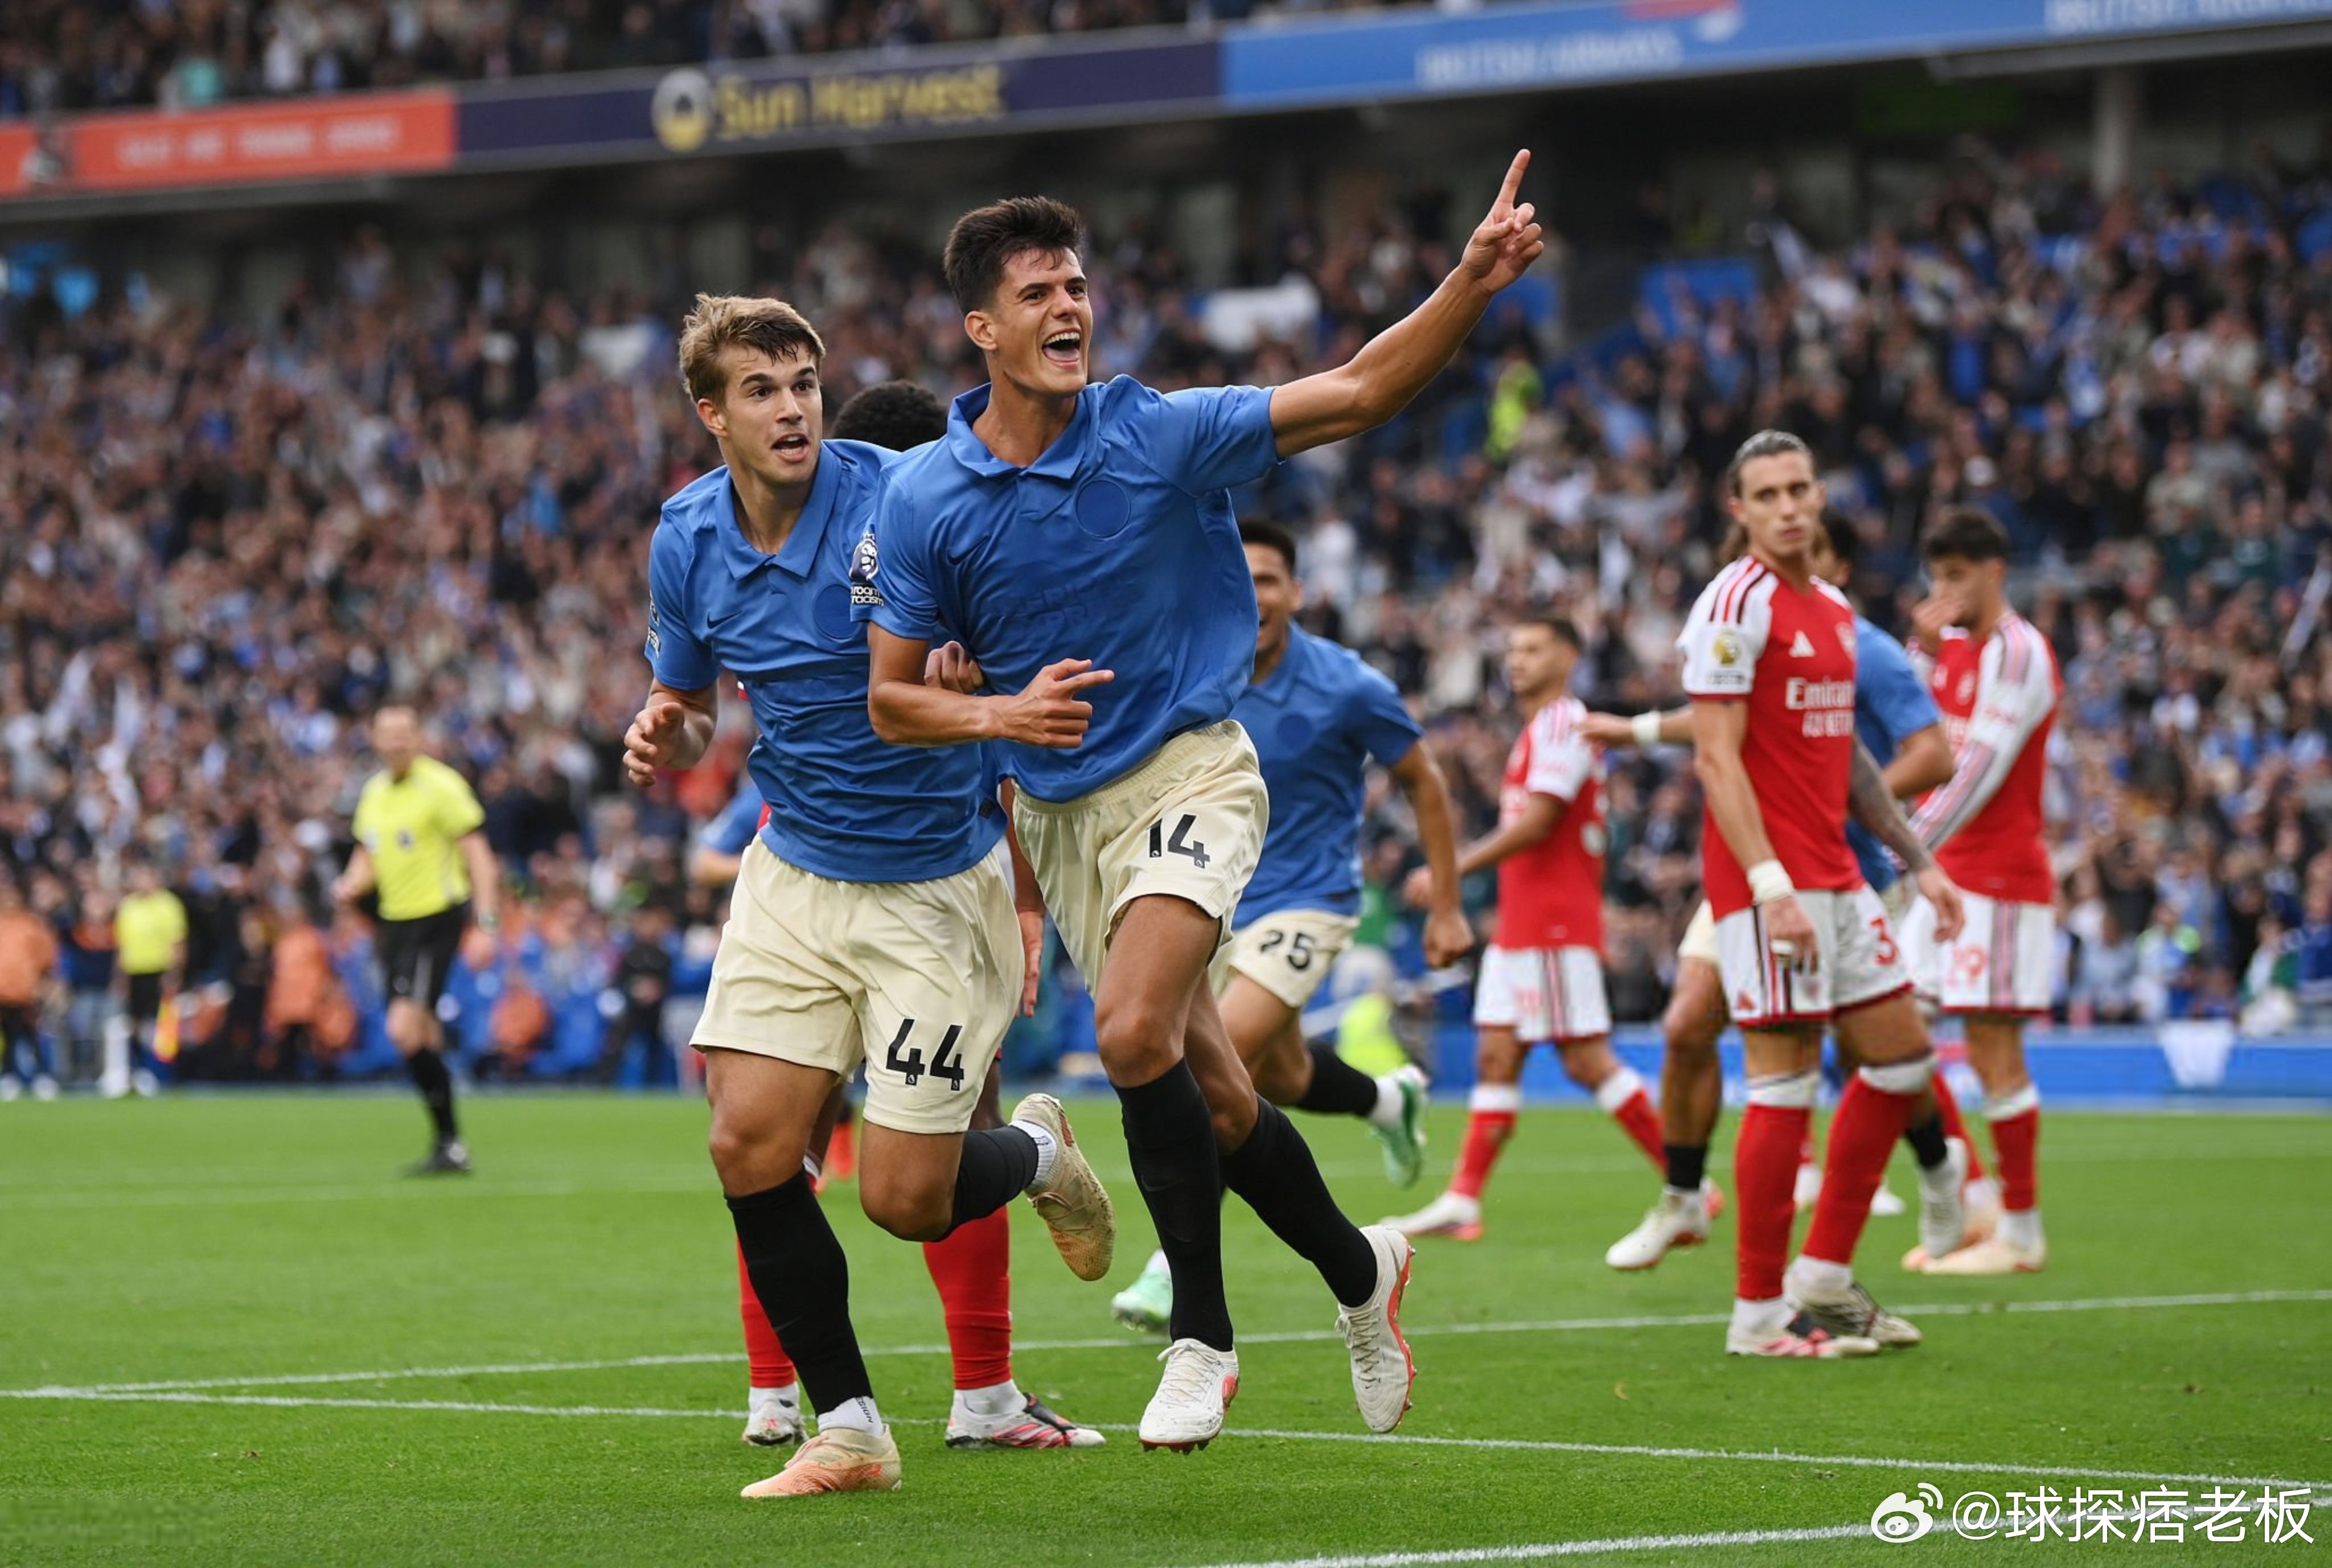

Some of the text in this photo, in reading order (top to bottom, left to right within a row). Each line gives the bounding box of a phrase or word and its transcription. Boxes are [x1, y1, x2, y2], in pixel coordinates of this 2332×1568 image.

[715, 63, 1003, 139] Sun Harvest
[1147, 814, 1210, 869] 14
[1259, 929, 1316, 972] 25
[886, 1018, 965, 1092] 44
